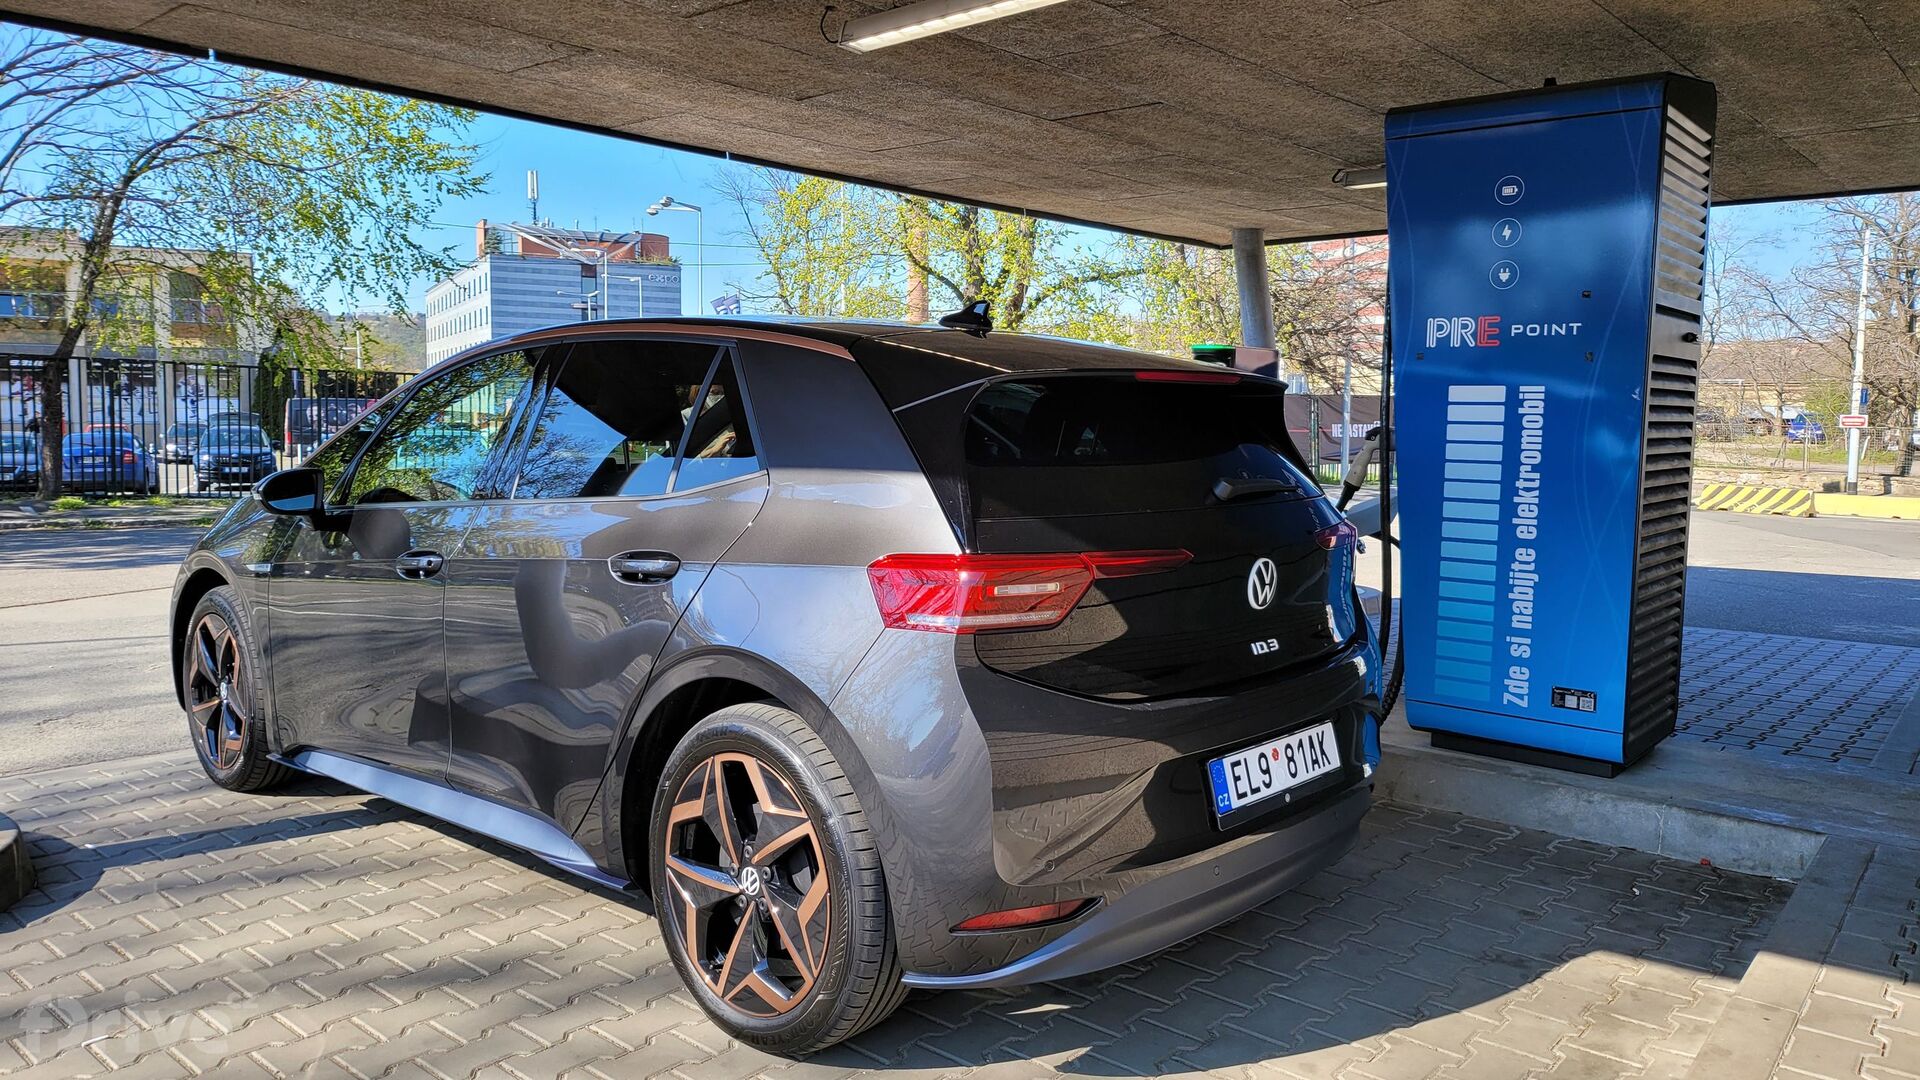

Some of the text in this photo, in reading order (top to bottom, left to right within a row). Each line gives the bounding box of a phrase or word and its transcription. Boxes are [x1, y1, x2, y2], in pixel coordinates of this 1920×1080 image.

[1426, 315, 1583, 348] PRE POINT
[1503, 385, 1546, 708] Zde si nabijte elektromobil
[1230, 730, 1331, 801] EL9 81AK
[1217, 793, 1230, 807] CZ
